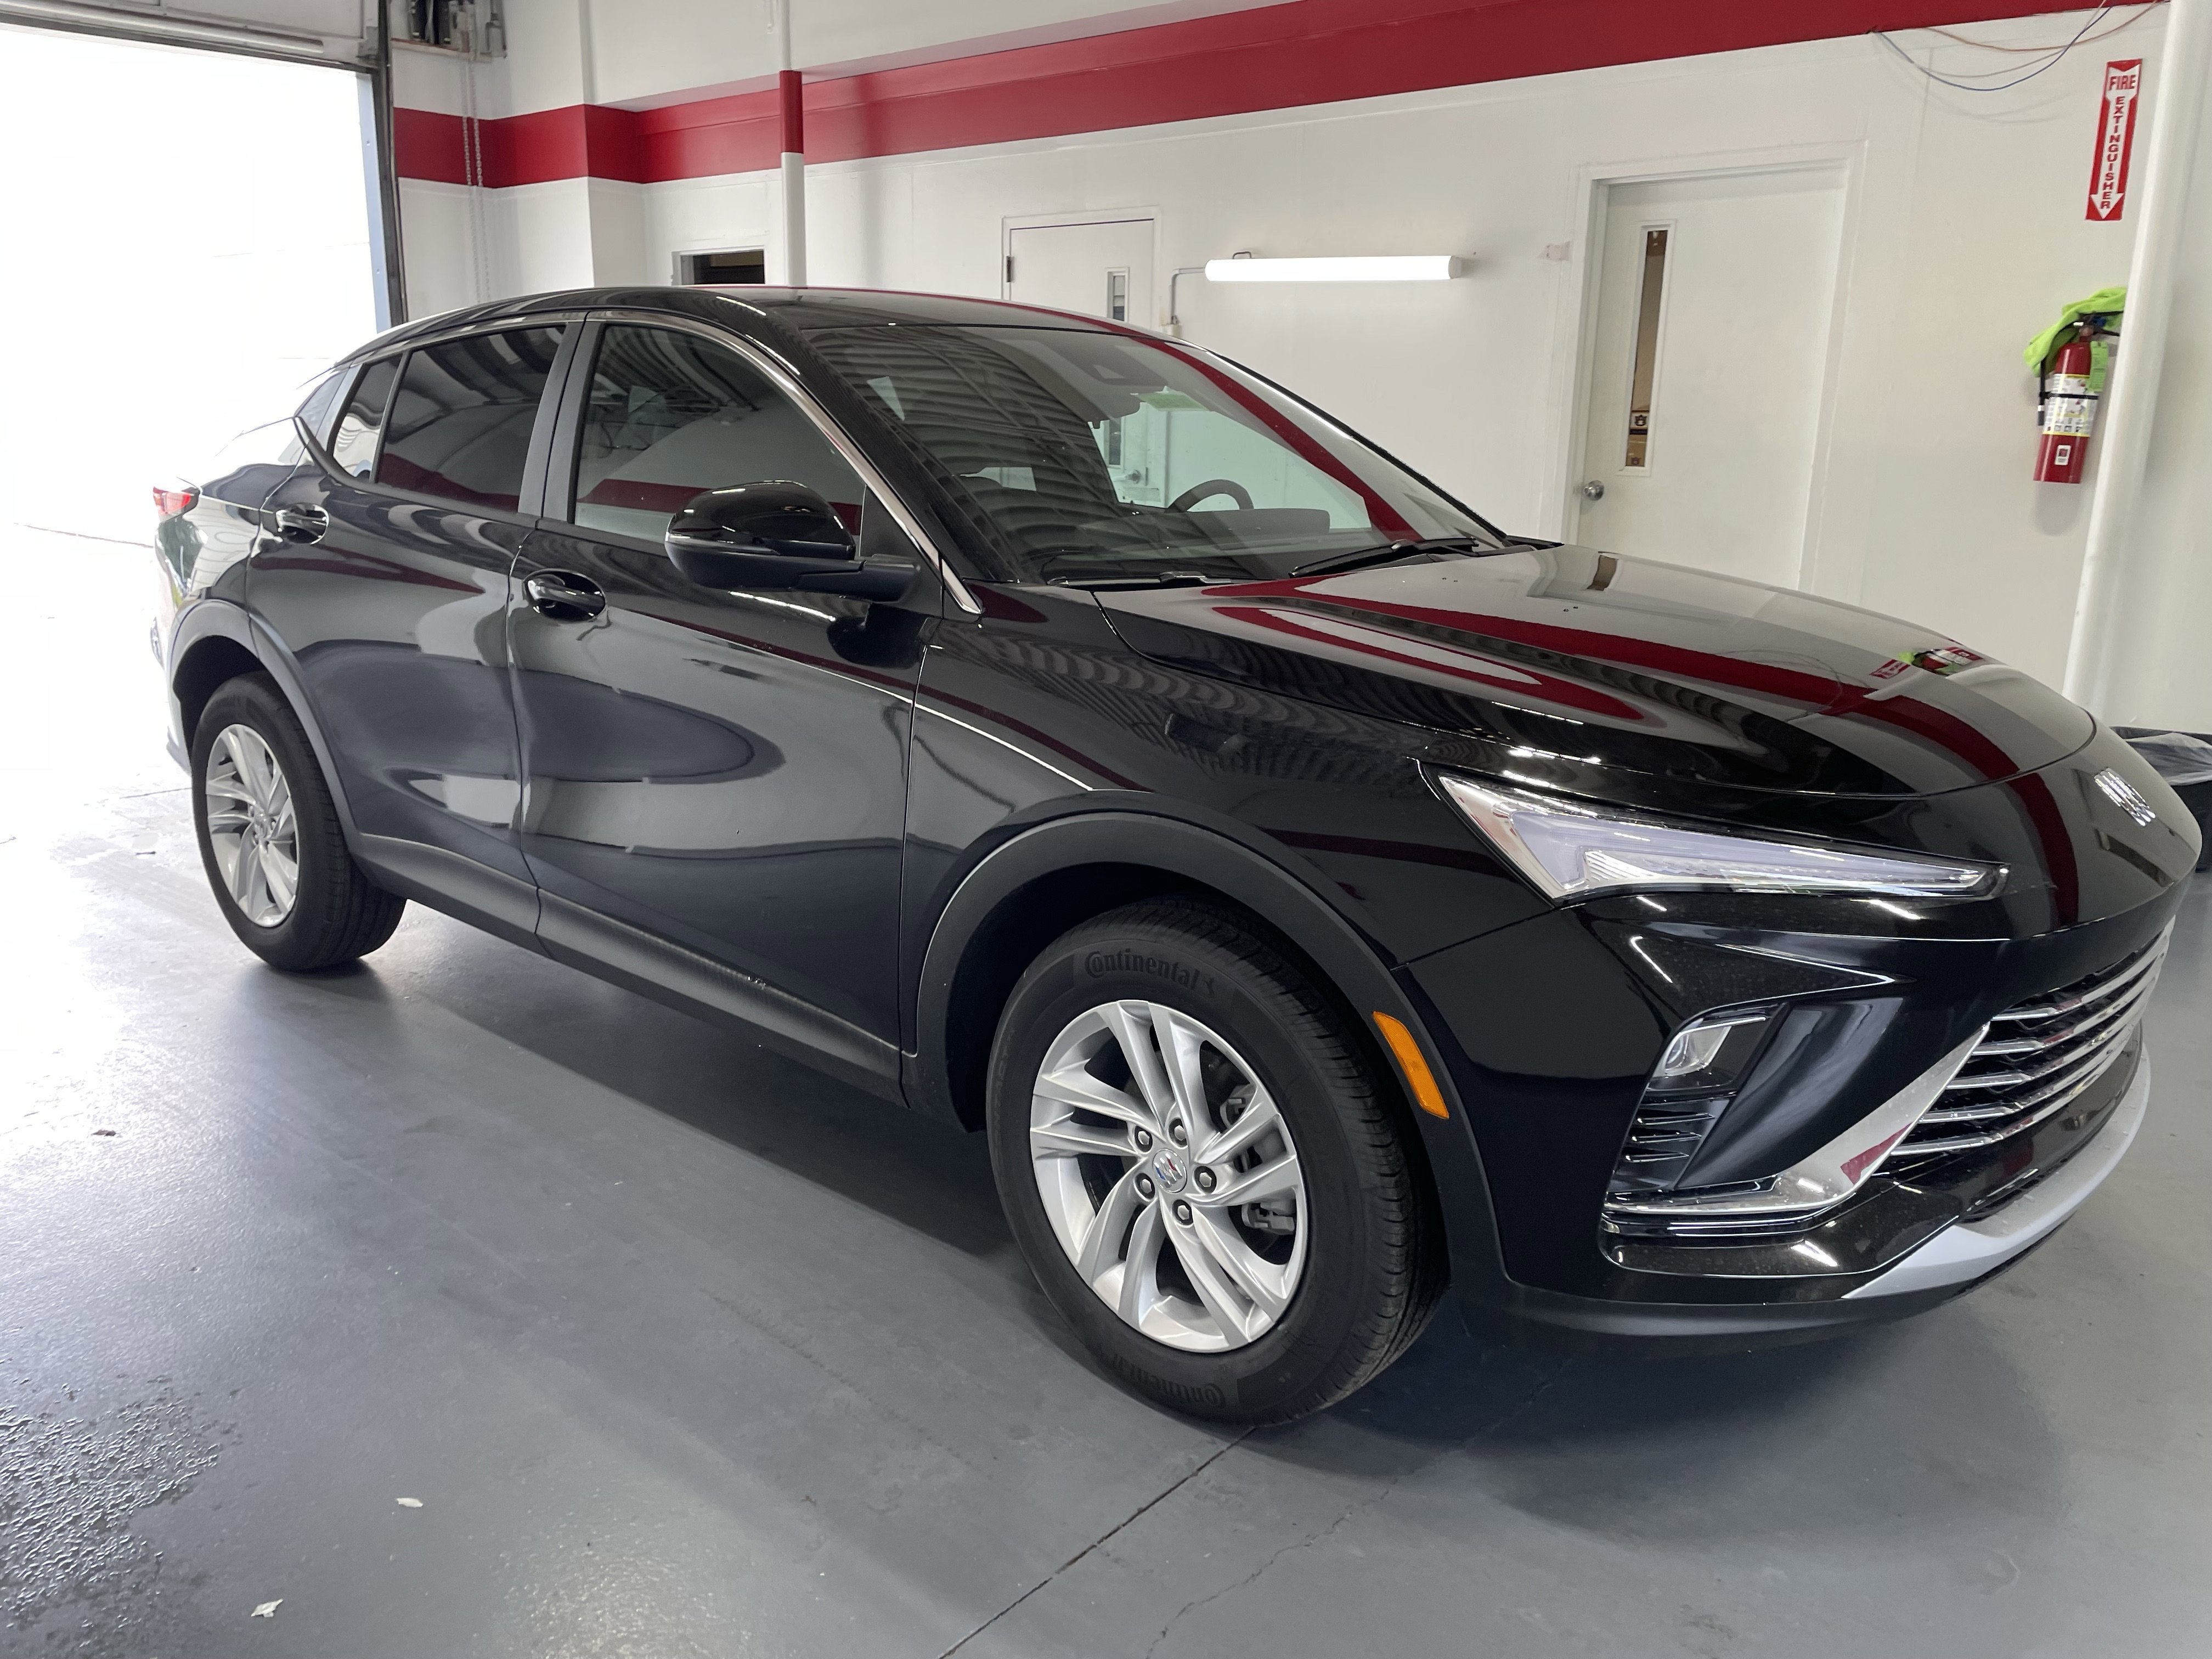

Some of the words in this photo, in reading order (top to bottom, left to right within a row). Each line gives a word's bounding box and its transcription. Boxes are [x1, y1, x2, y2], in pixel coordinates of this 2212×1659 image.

[2108, 75, 2136, 91] FIRE
[2100, 96, 2126, 210] EXTINGUISHER
[1085, 948, 1200, 989] Continental
